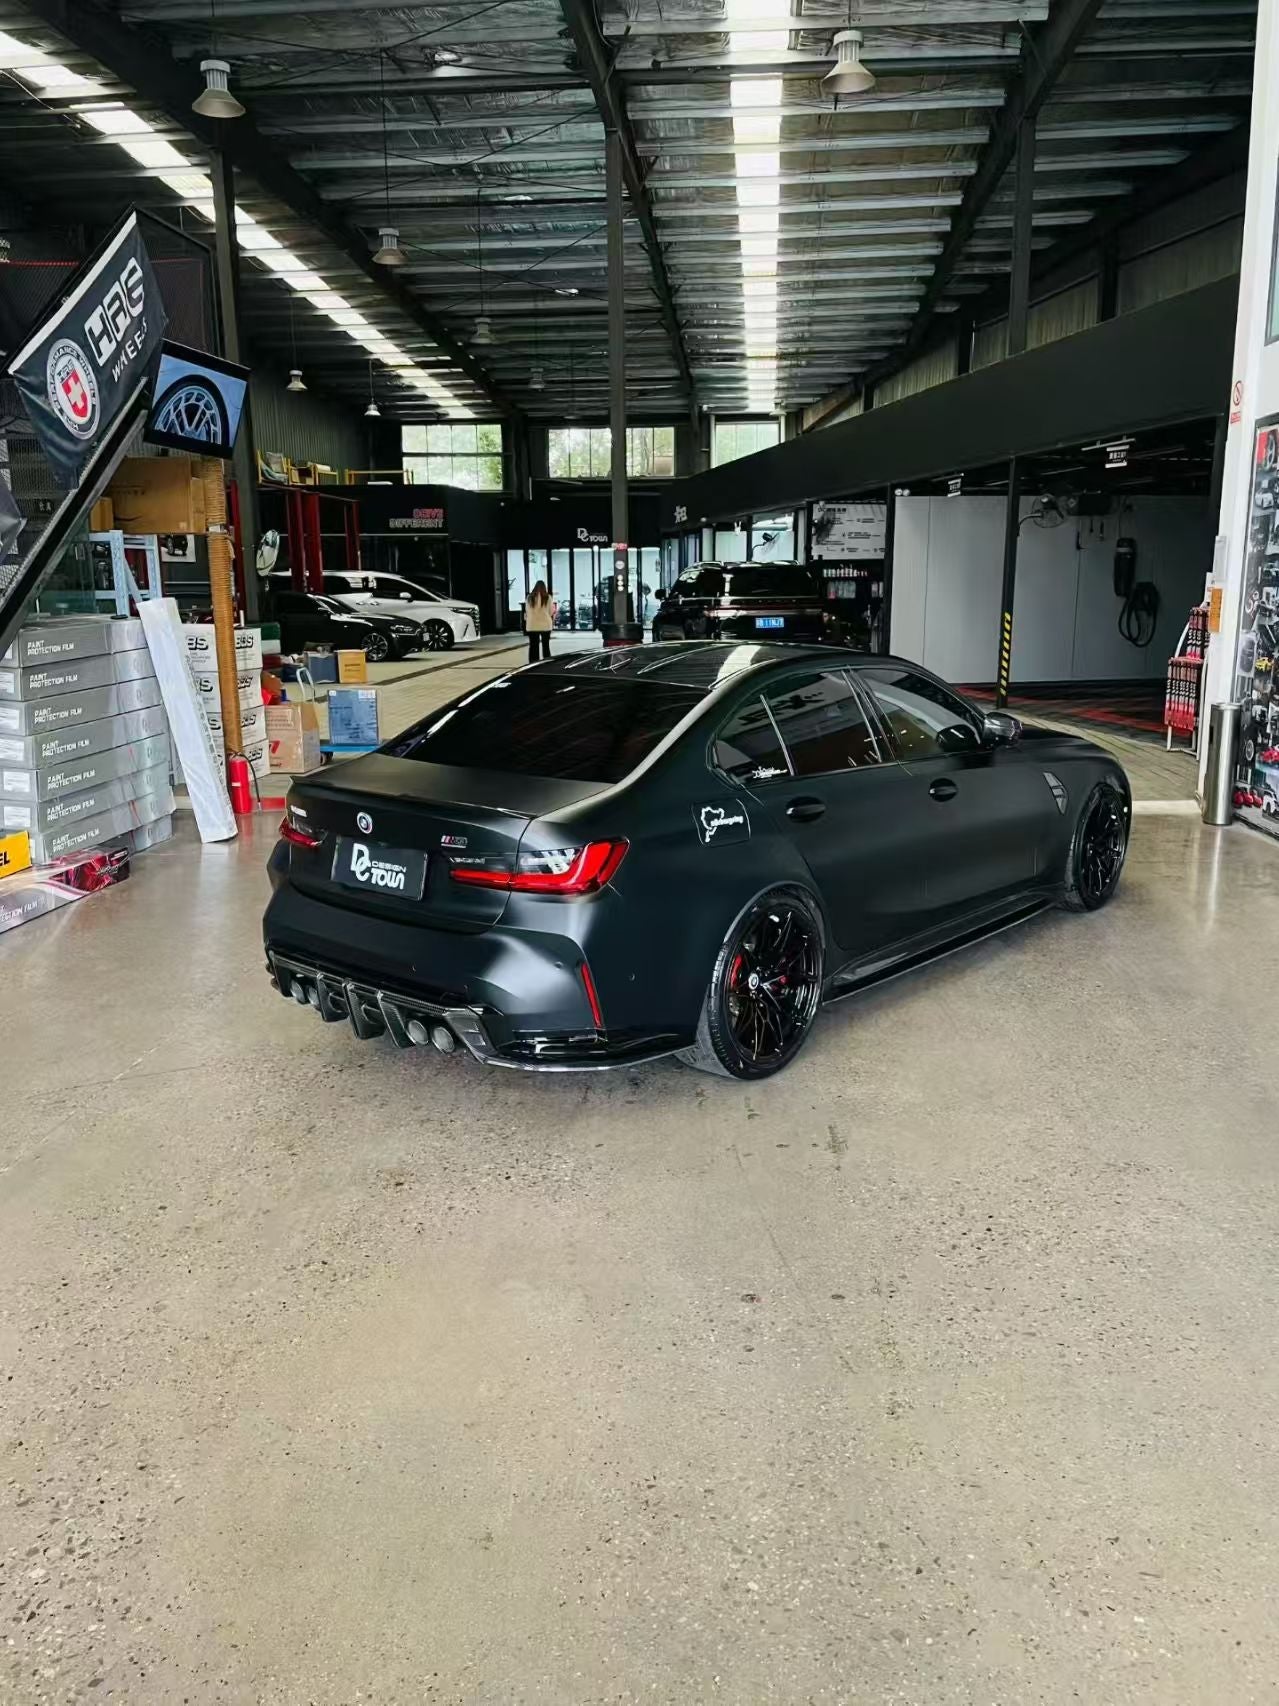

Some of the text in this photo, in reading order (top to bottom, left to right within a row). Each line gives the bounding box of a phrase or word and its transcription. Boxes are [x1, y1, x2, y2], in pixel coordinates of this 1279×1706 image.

[84, 257, 144, 367] HRE
[27, 640, 45, 649] PAINT
[27, 645, 61, 656] PROTECTION
[29, 674, 78, 689] PROTECTION FILM
[30, 673, 48, 682] PAINT
[34, 708, 52, 717] PAINT
[34, 708, 82, 724] PROTECTION FILM
[42, 740, 59, 750] PAINT
[42, 739, 90, 757] PROTECTION FILM
[47, 772, 65, 783] PAINT
[47, 769, 96, 790] PROTECTION FILM
[47, 803, 64, 814] PAINT
[47, 799, 95, 821] PROTECTION FILM
[52, 834, 70, 846] PAINT
[53, 828, 100, 853] PROTECTION FILM
[371, 860, 406, 873] DESIGN
